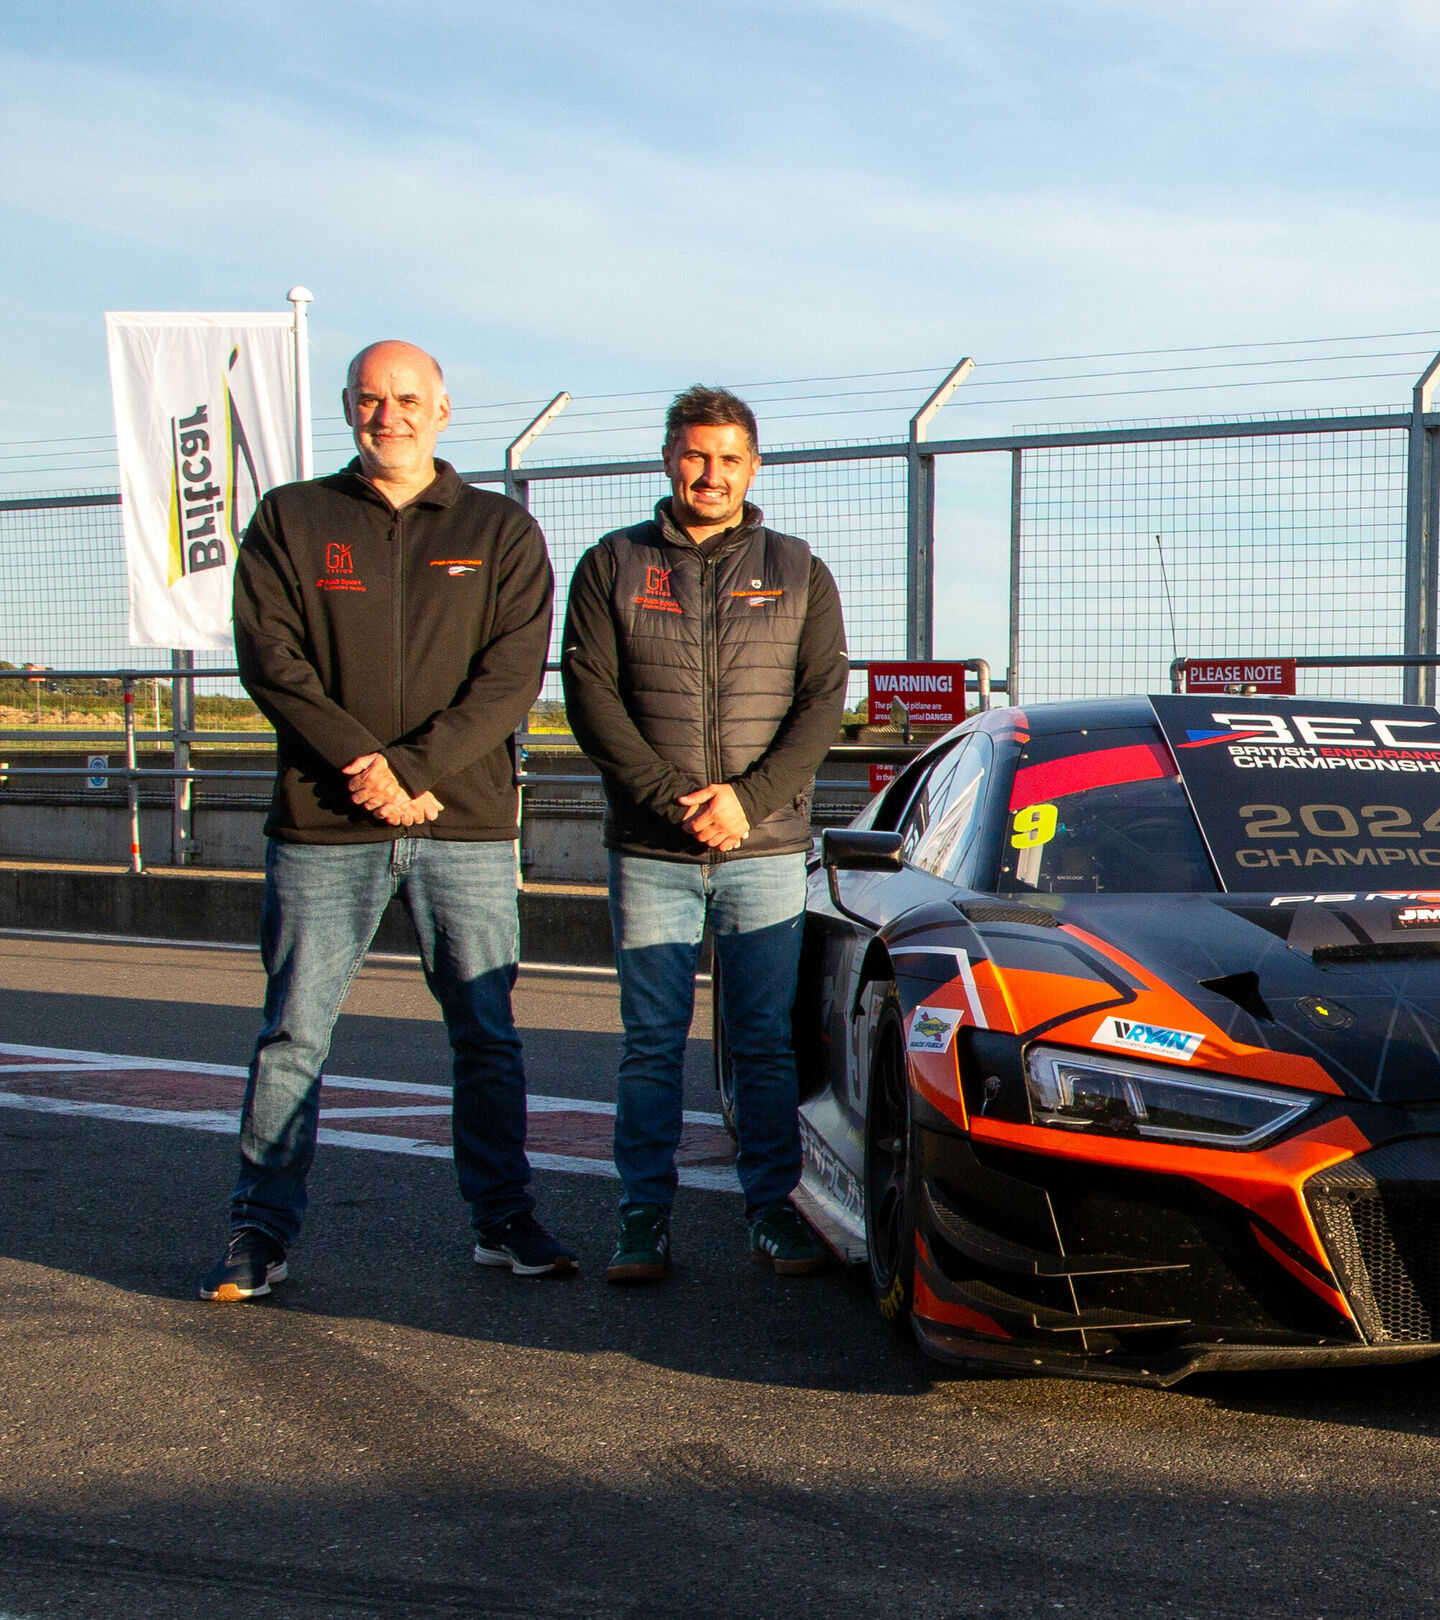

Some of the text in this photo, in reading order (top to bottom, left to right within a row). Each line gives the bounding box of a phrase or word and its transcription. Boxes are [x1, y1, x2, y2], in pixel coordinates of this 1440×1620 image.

[1190, 665, 1282, 682] PLEASE NOTE
[874, 675, 953, 692] WARNING!
[875, 701, 886, 710] The
[910, 701, 931, 711] pitlane
[926, 713, 953, 721] DANGER
[1228, 745, 1316, 757] BRITISH
[1011, 803, 1059, 849] 9
[1269, 893, 1357, 907] PB
[910, 1040, 944, 1049] RACE FUELS
